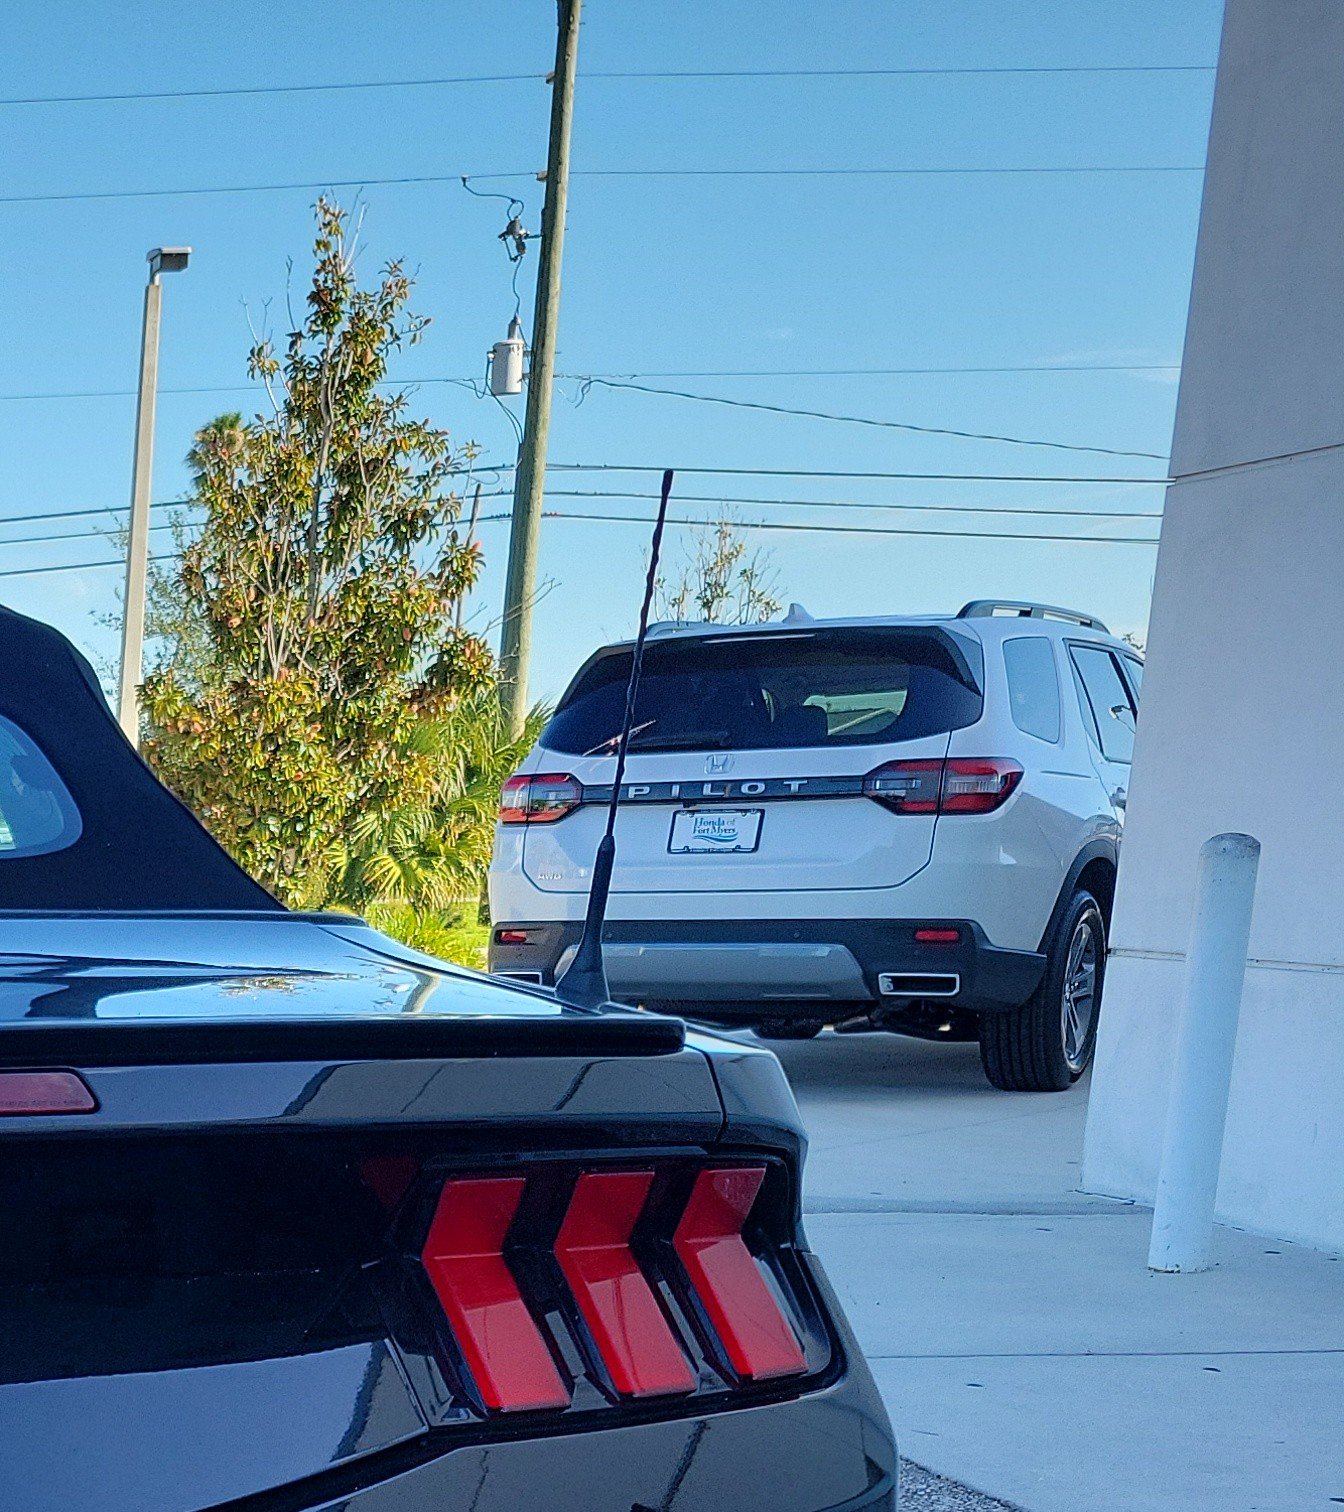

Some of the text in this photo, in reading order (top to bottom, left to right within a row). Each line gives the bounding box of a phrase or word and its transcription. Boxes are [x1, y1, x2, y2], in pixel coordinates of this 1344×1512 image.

[628, 780, 808, 799] PILOT
[693, 817, 725, 827] Honda
[693, 826, 736, 836] Fort Myers
